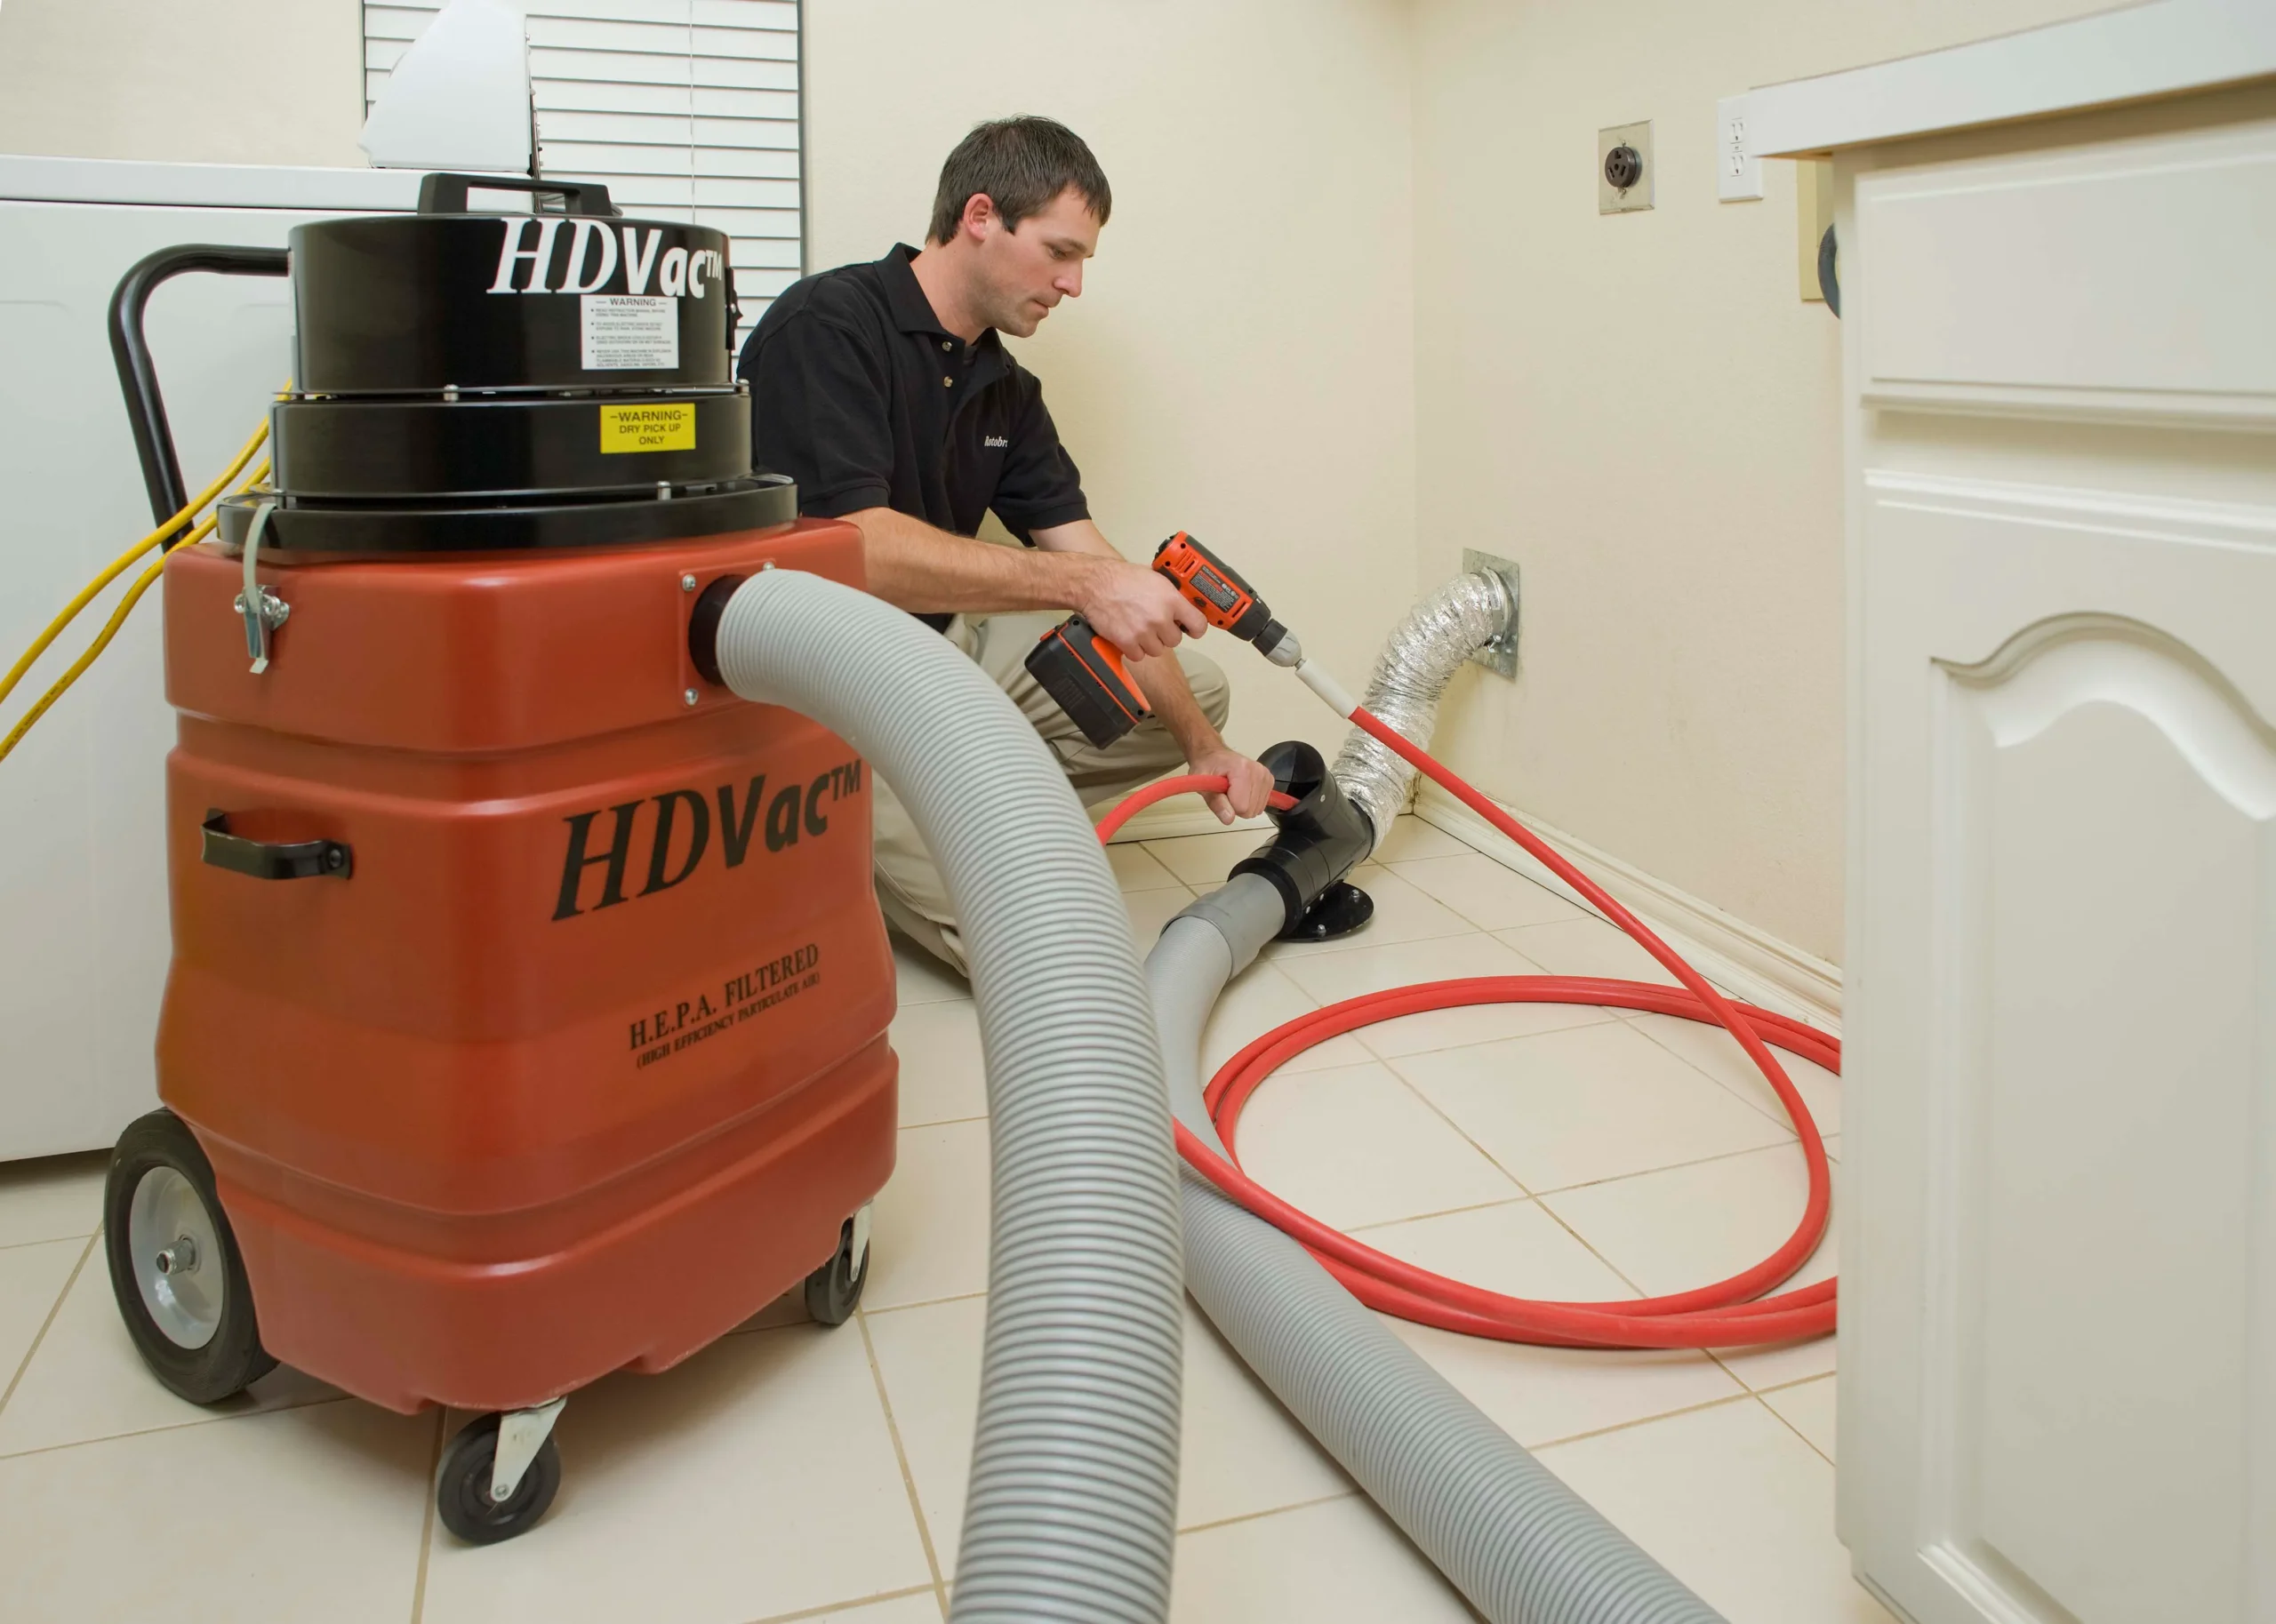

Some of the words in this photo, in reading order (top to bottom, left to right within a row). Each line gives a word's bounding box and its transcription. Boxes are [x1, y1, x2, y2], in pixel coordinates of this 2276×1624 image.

[610, 298, 656, 307] WARNING
[620, 425, 640, 434] DRY
[644, 424, 665, 433] PICK
[669, 423, 681, 432] UP
[639, 436, 664, 444] ONLY
[629, 994, 717, 1050] H.E.P.A.
[725, 943, 819, 1007] FILTERED
[637, 1044, 670, 1069] (HIGH
[674, 1013, 734, 1052] EFFICIENCY
[738, 987, 799, 1021] PARTICULATE
